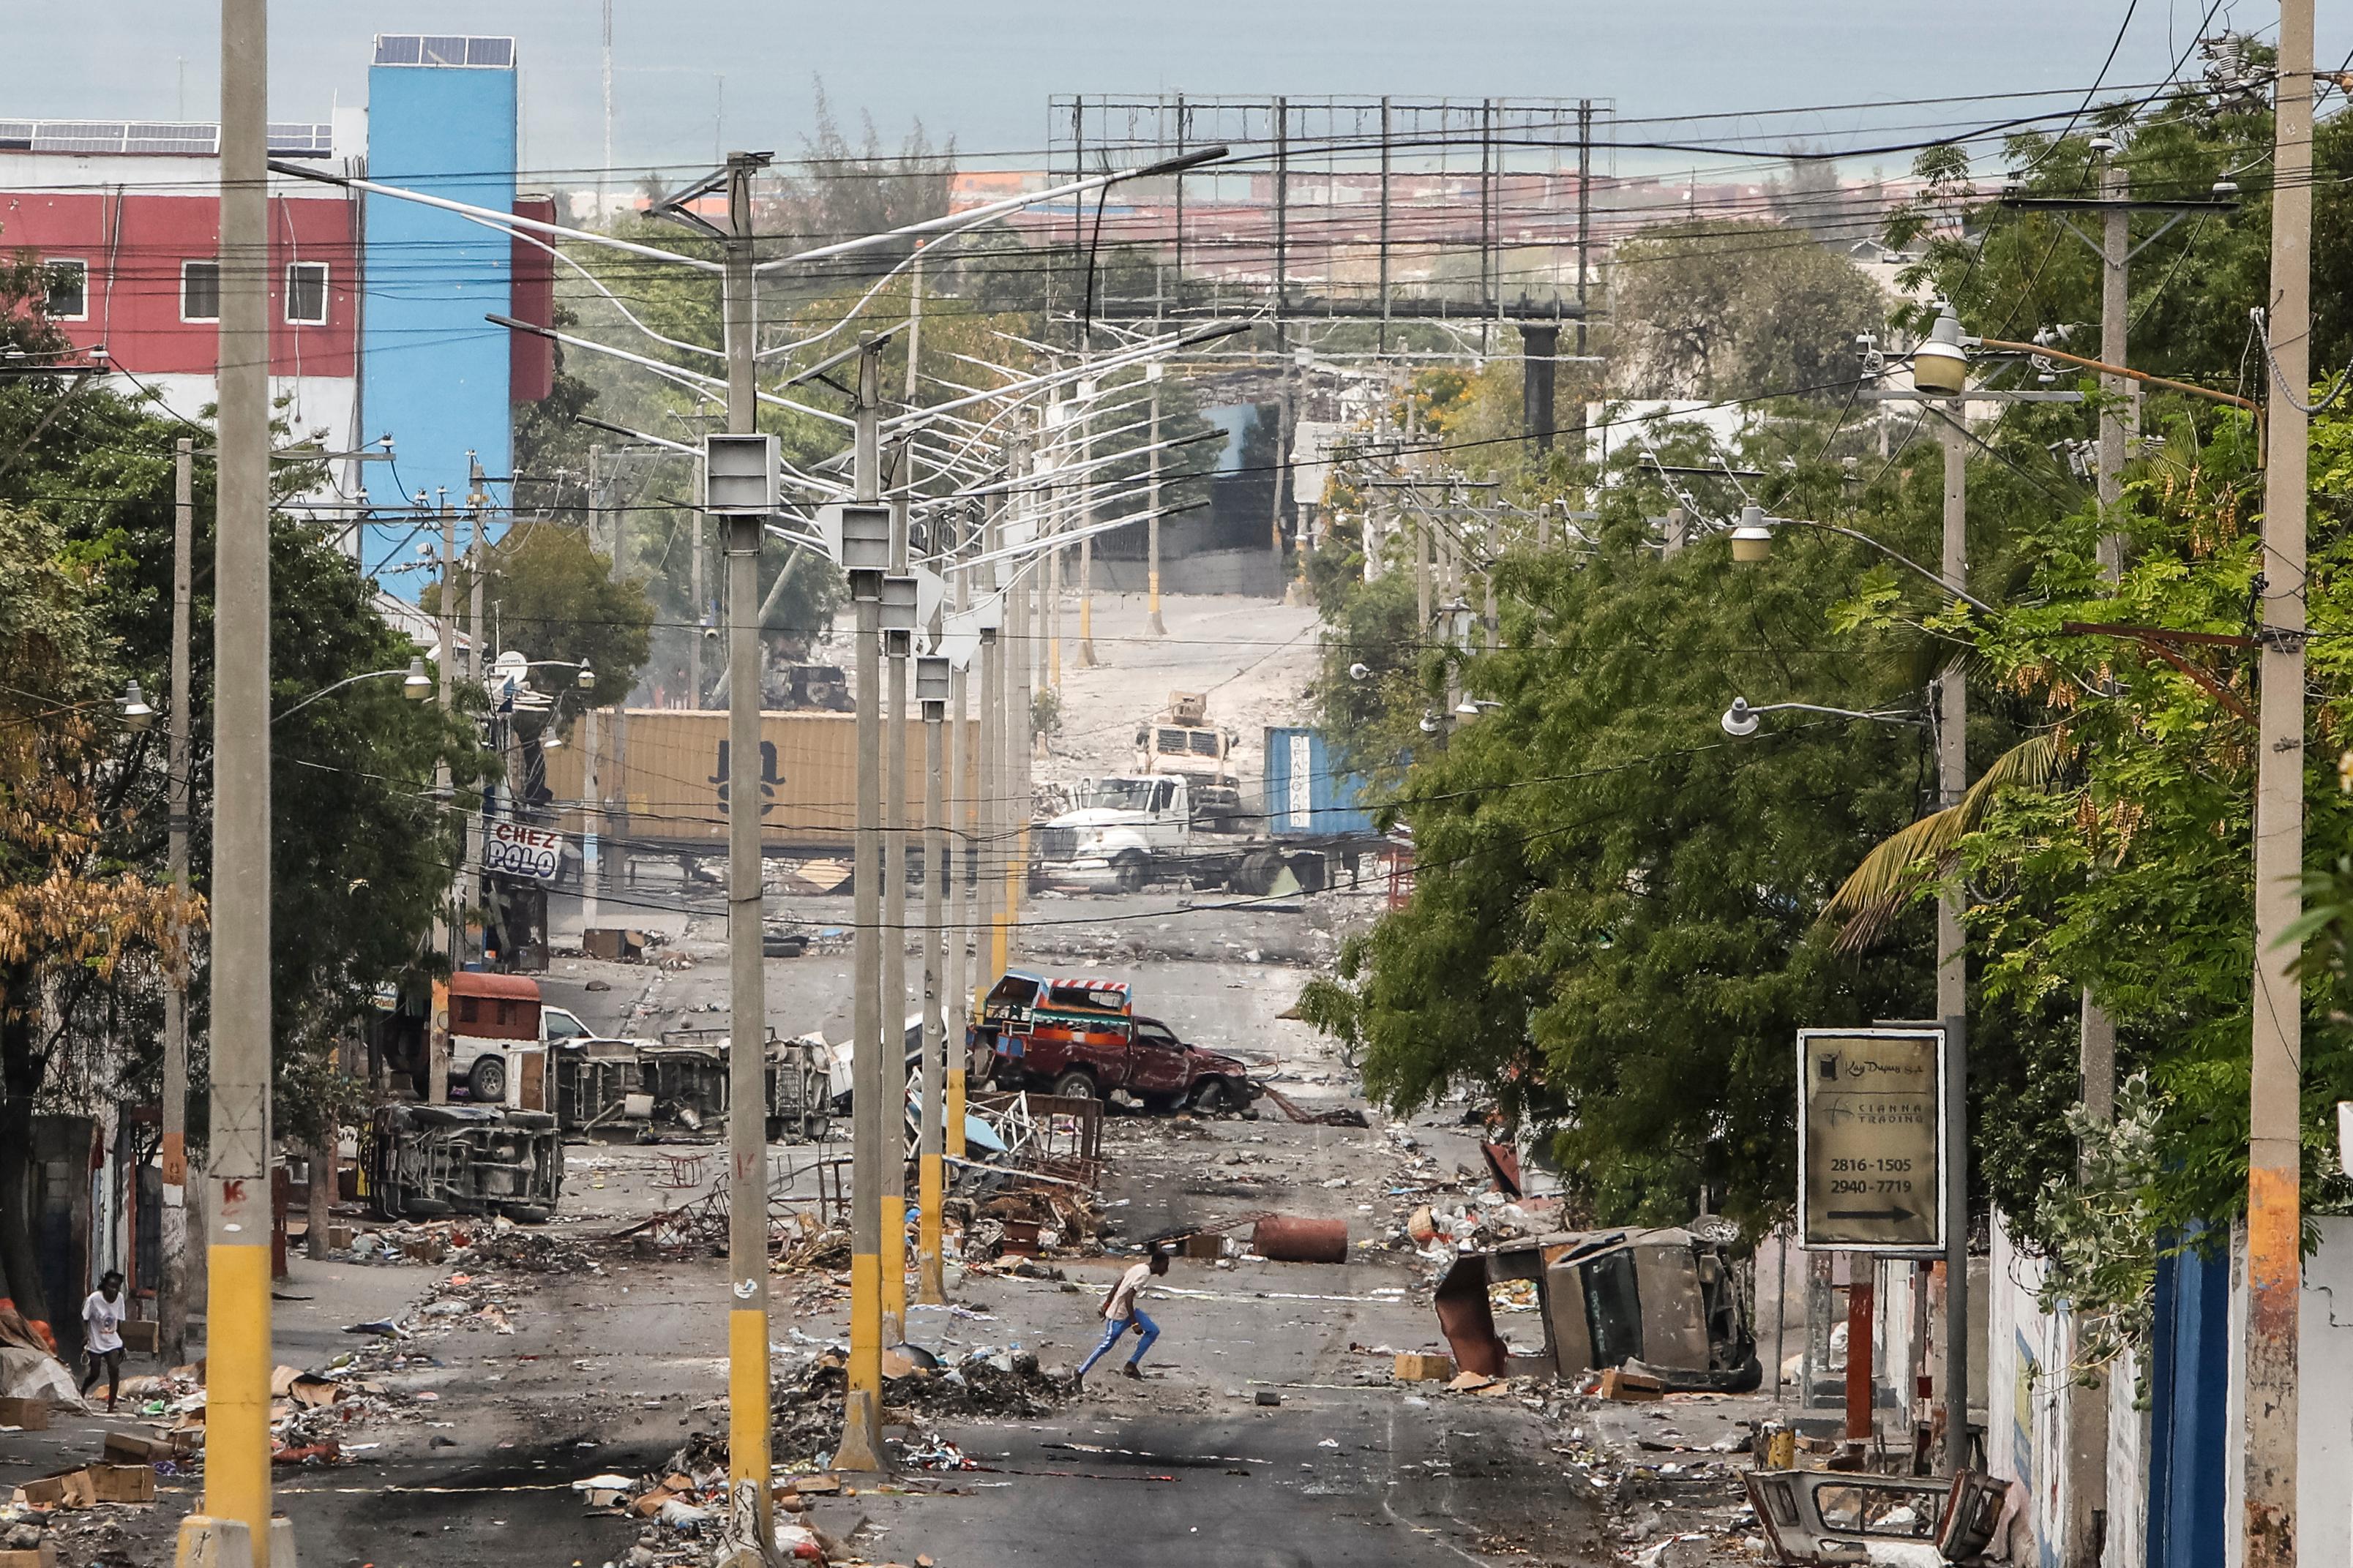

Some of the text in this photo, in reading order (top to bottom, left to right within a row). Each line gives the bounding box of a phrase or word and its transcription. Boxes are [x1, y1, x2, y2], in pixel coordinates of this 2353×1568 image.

[495, 823, 557, 849] CHEZ
[487, 840, 555, 878] POLO
[1845, 1060, 1866, 1077] Kay
[1858, 1104, 1921, 1113] CIANNA
[1859, 1116, 1923, 1125] TRADING
